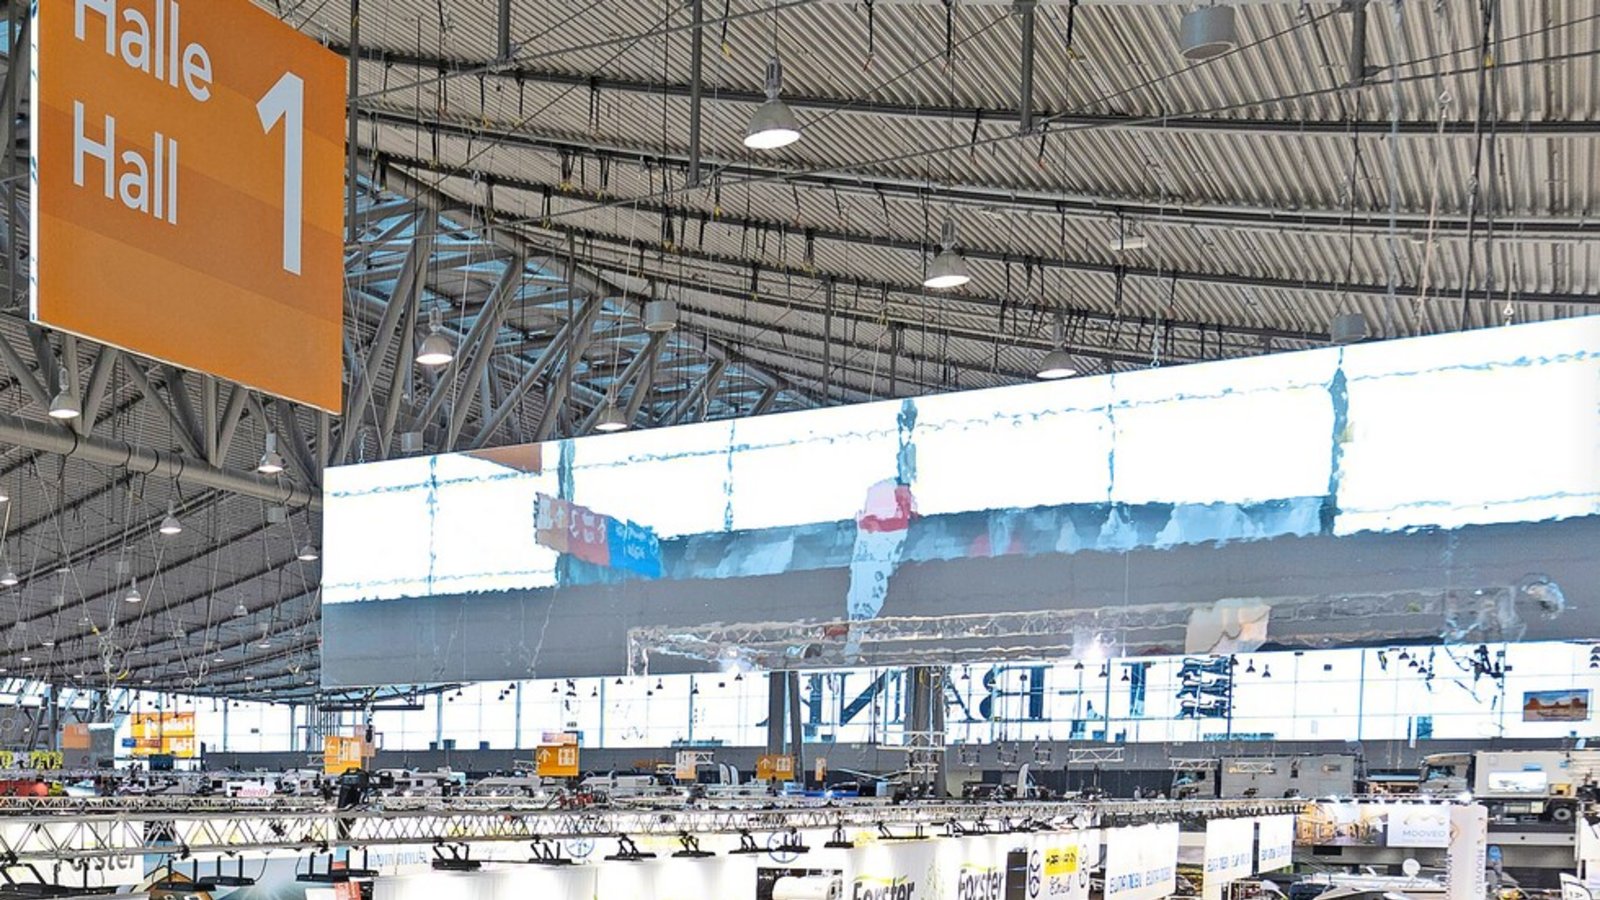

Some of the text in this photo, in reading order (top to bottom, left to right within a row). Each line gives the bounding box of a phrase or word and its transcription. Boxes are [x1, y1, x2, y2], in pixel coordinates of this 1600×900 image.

[74, 0, 213, 102] Halle
[73, 100, 178, 226] Hall
[256, 71, 304, 276] 1
